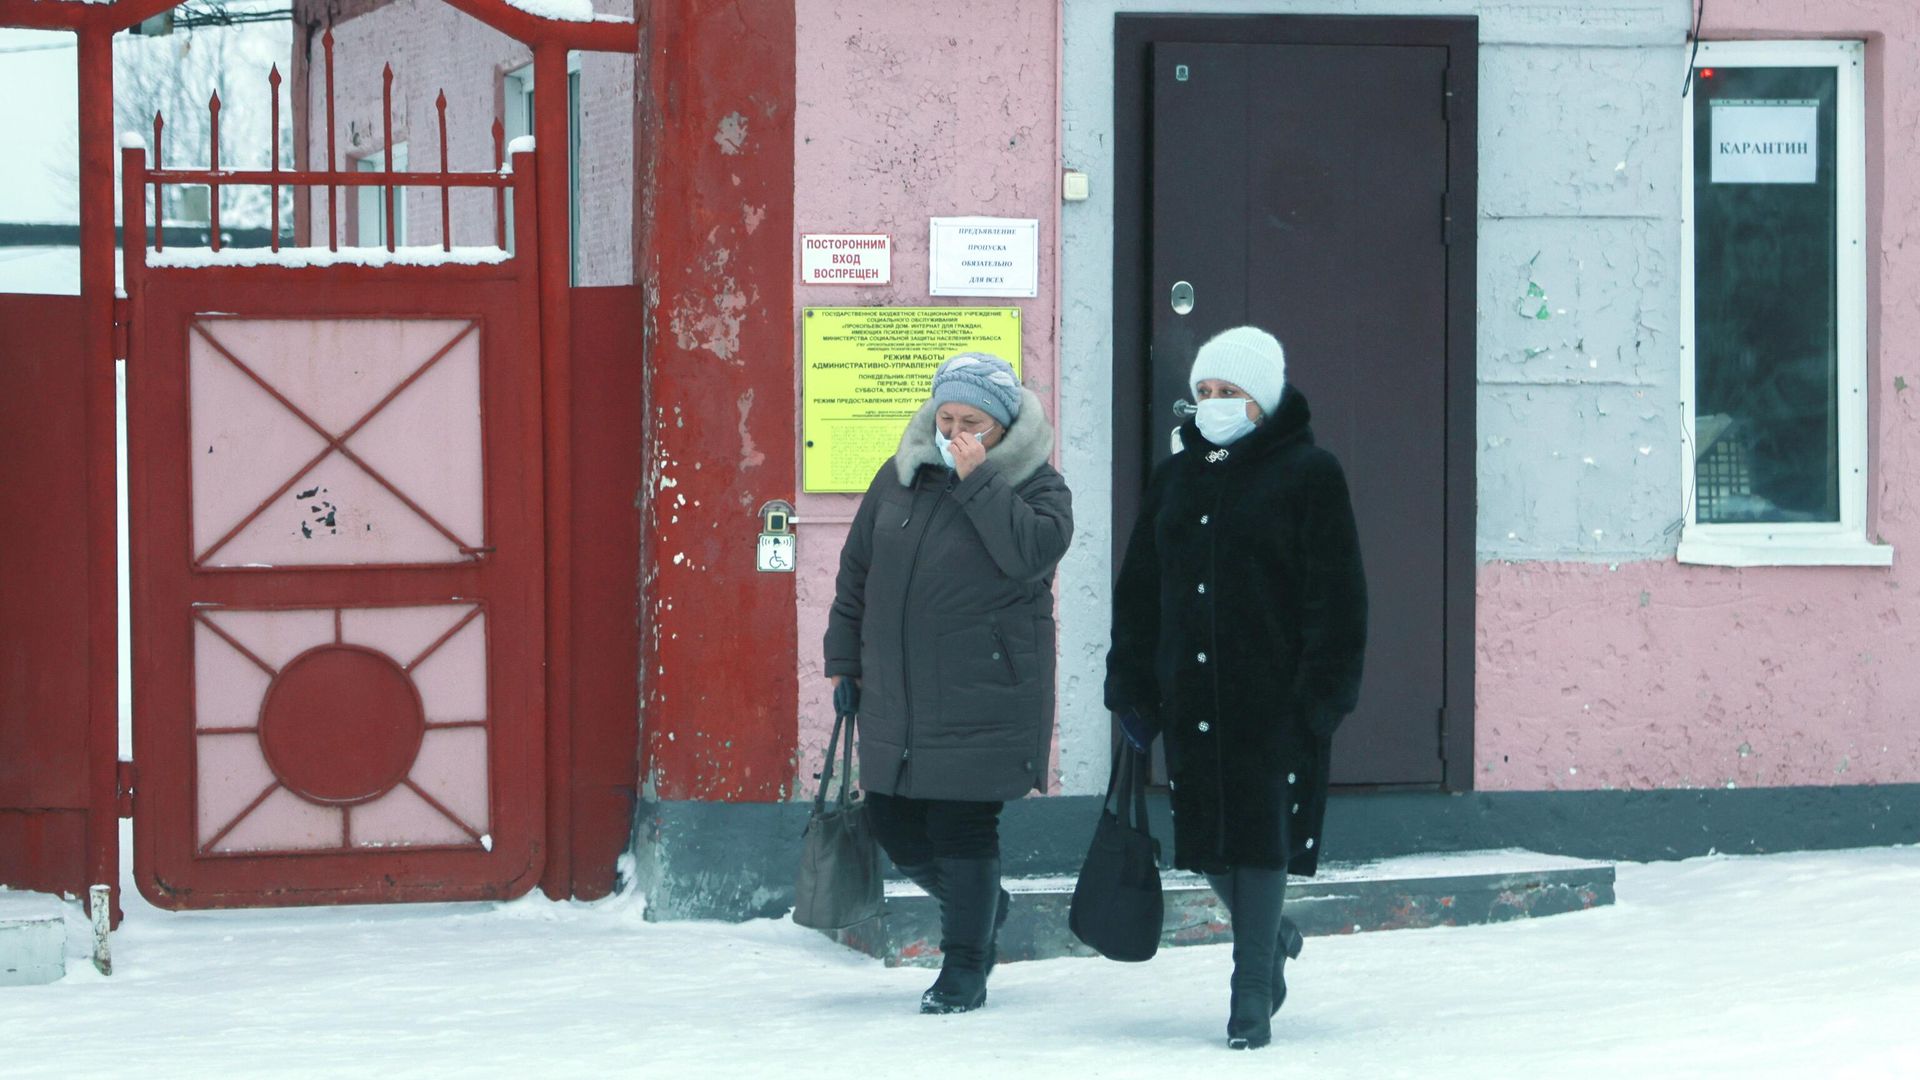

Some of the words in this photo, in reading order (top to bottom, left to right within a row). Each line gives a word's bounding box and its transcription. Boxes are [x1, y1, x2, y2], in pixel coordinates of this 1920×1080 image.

[1720, 142, 1808, 154] КАРАНТИН
[959, 228, 1016, 236] ПРЕДЪЯВЛЕНИЕ
[806, 239, 886, 249] ПОСТОРОННИМ
[832, 254, 861, 265] ВХОД
[814, 268, 879, 280] ВОСПРЕЩЕН
